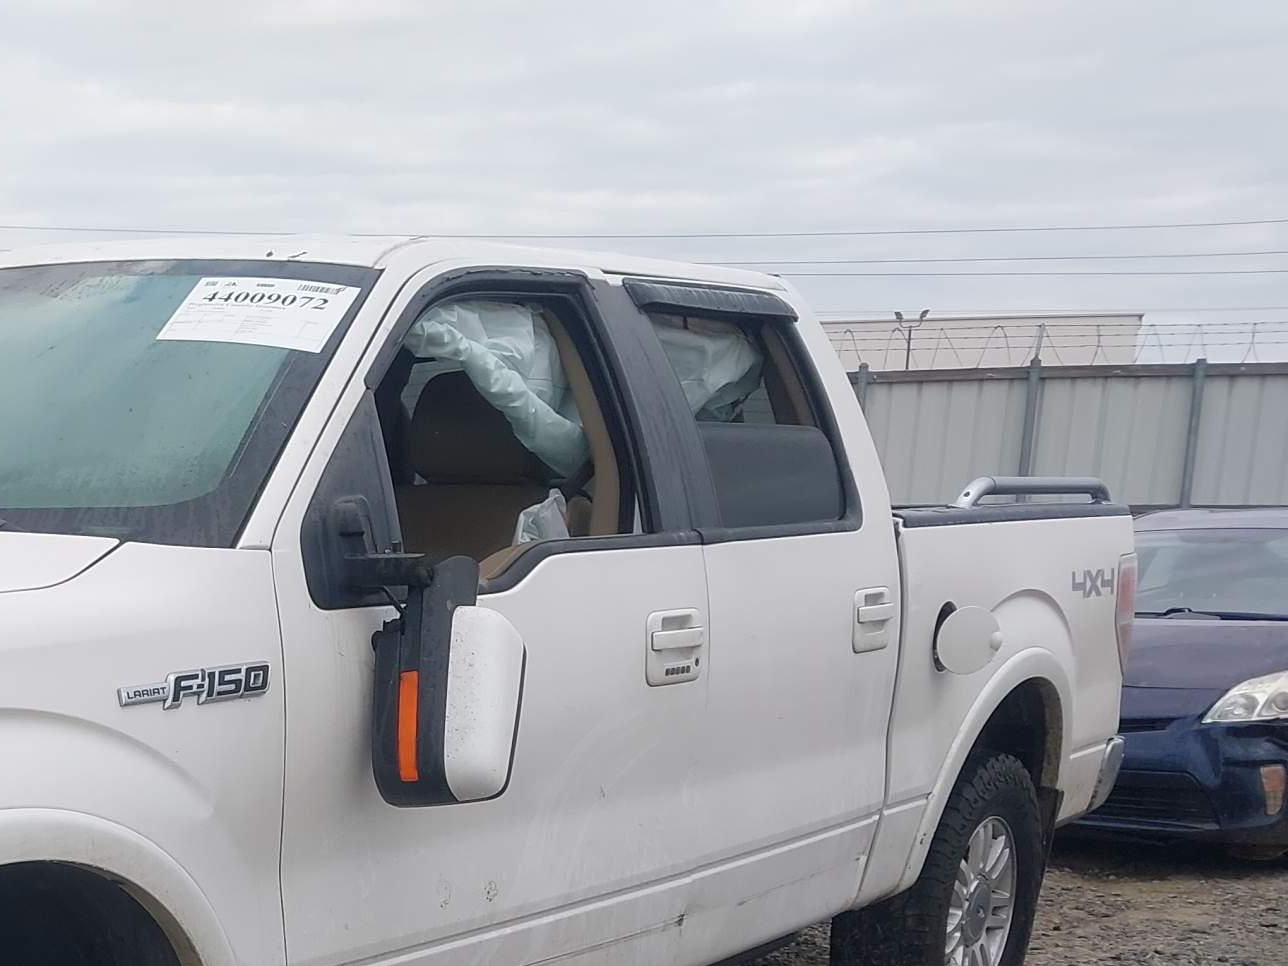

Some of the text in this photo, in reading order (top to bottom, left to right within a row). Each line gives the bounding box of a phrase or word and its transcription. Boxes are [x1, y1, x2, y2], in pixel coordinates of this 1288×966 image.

[203, 290, 329, 310] 44009072
[126, 663, 270, 704] LARIAT F-150
